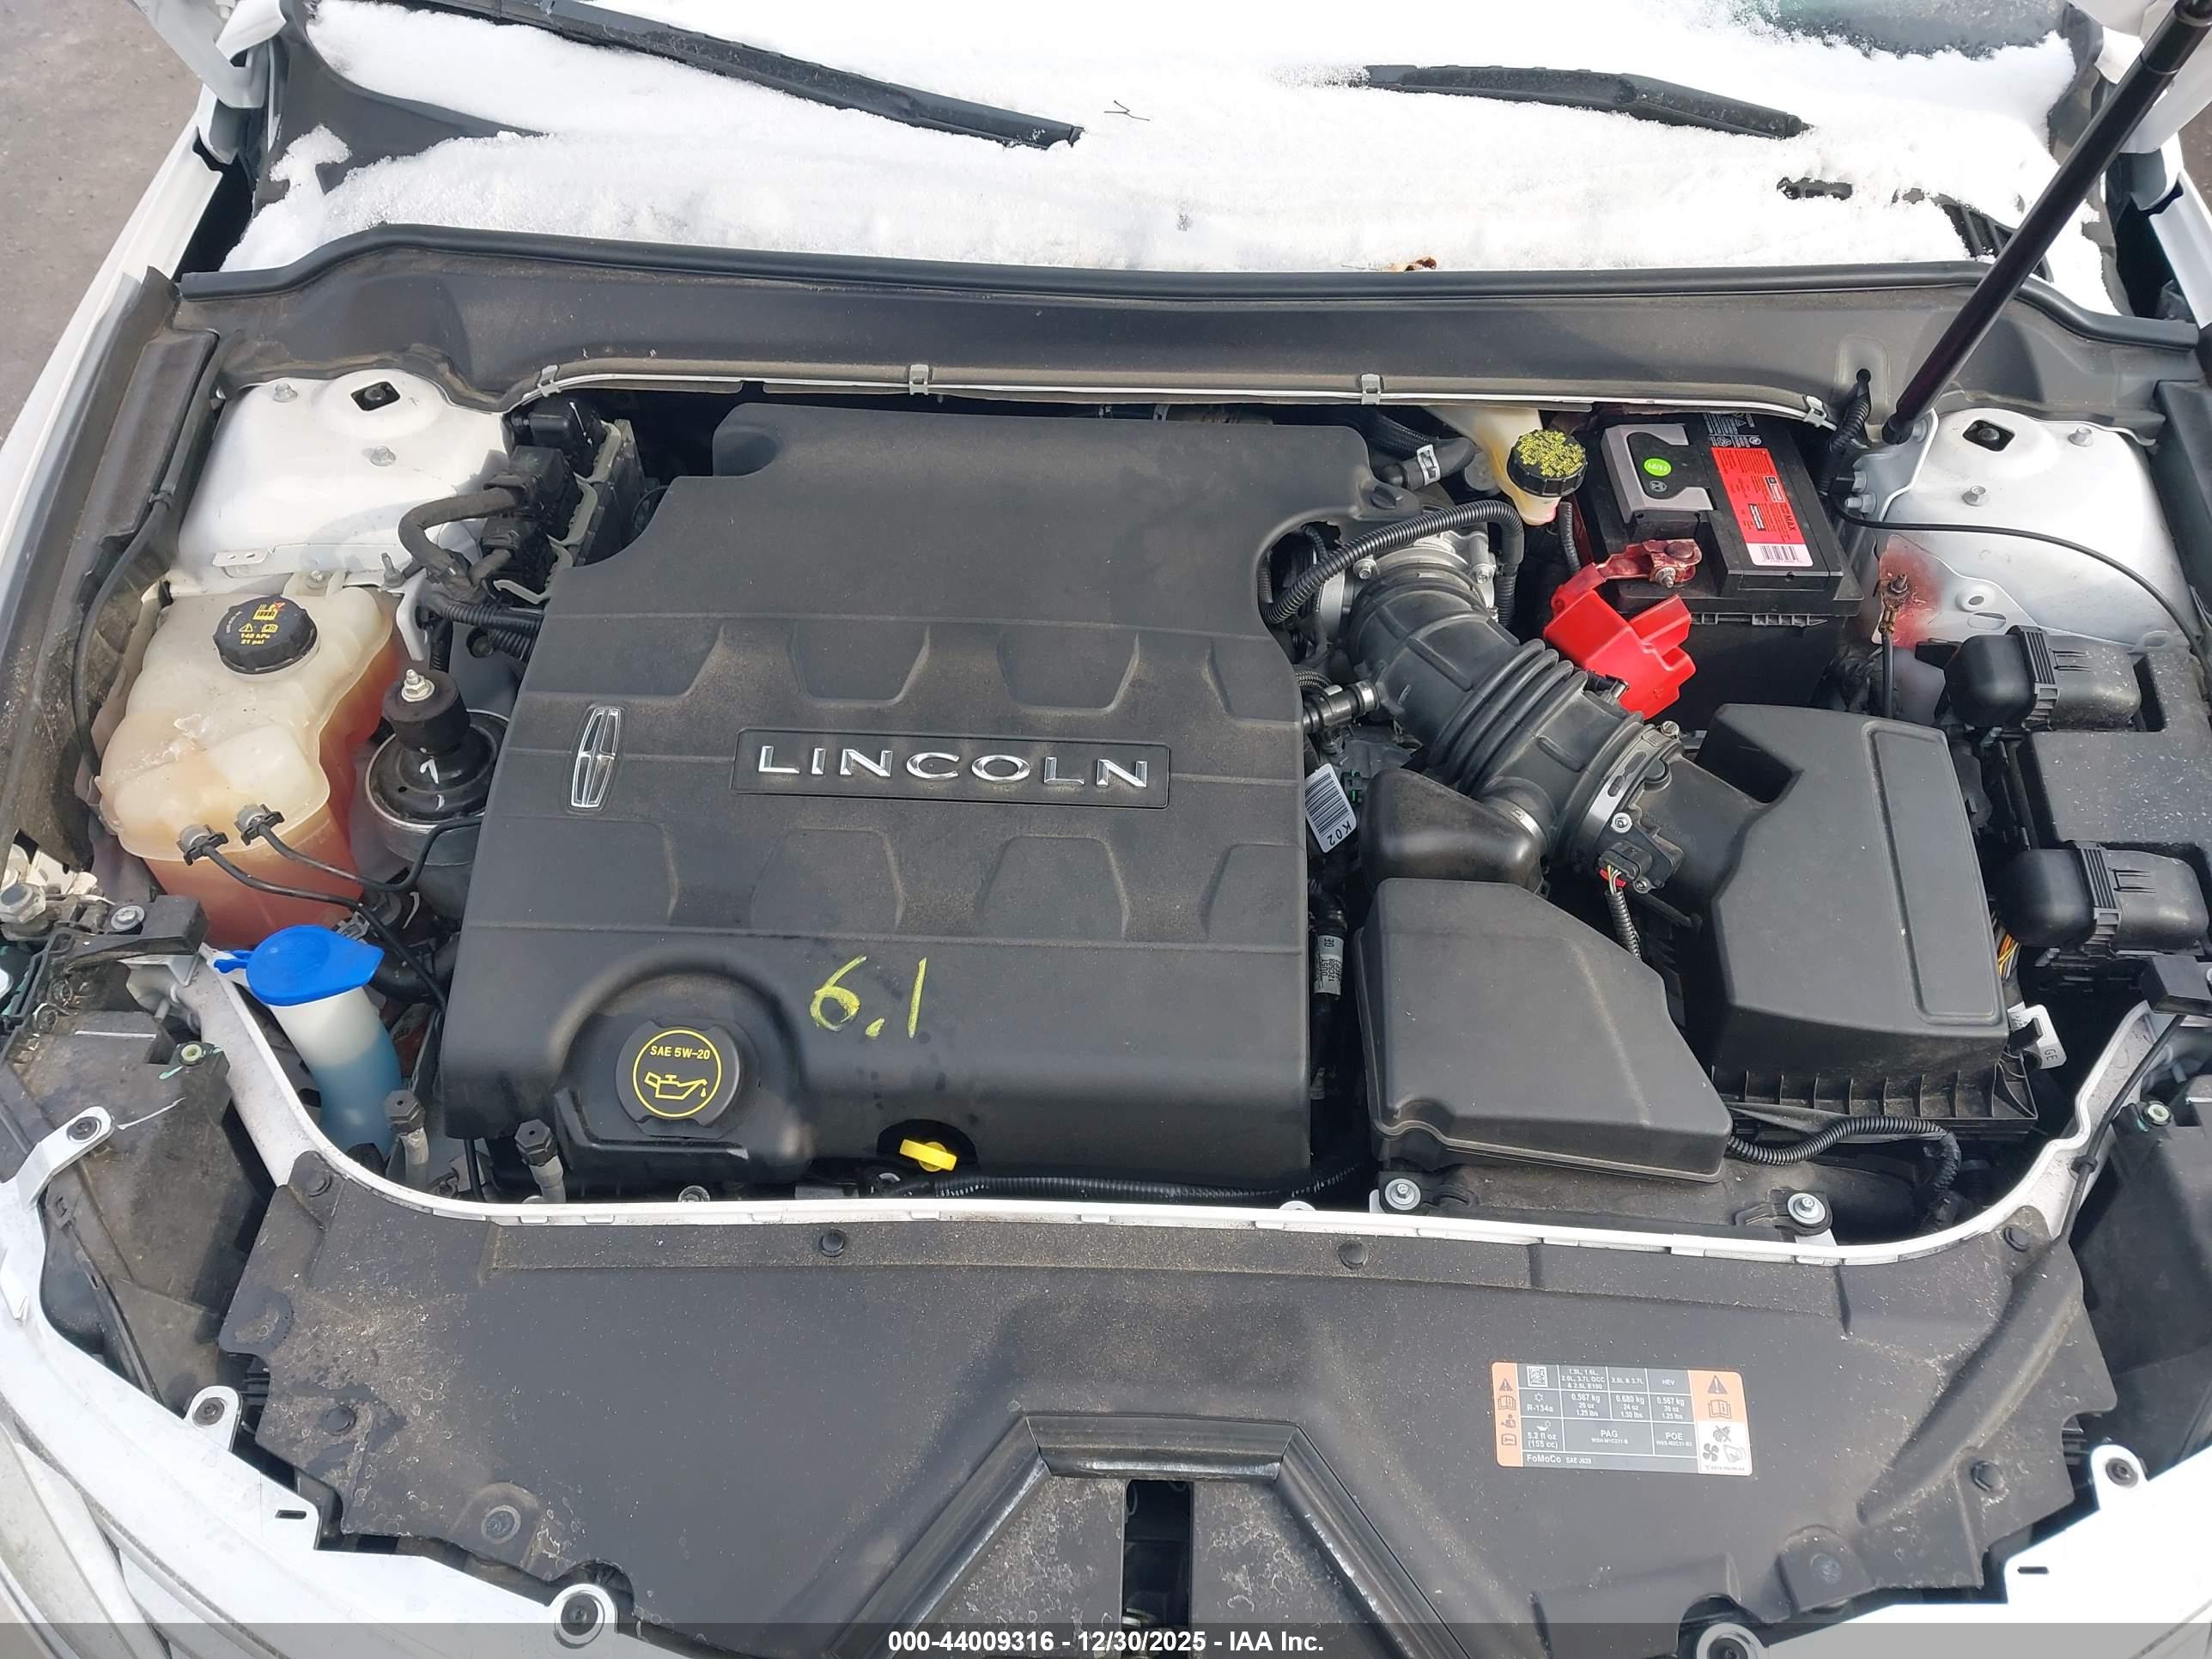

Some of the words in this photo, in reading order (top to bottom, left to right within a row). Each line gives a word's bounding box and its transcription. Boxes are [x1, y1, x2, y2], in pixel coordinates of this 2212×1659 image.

[758, 744, 1148, 788] LINCOLN
[1327, 820, 1352, 846] K02
[810, 955, 927, 1039] 6.1
[650, 1044, 672, 1058] SAE
[673, 1045, 711, 1060] 5W-20
[2045, 1048, 2058, 1061] GE
[1571, 1393, 1589, 1401] 0.567
[1591, 1394, 1601, 1403] kg
[1615, 1395, 1635, 1403] 0.680
[1636, 1395, 1645, 1405] kg
[1656, 1396, 1674, 1405] 0.567
[1675, 1397, 1685, 1407] kg
[1526, 1404, 1553, 1413] R-134a
[1527, 1431, 1539, 1440] 5.2
[1600, 1429, 1618, 1437] PAG
[1665, 1431, 1683, 1441] POE
[1528, 1440, 1545, 1449] (155
[1546, 1441, 1559, 1449] cc)
[1526, 1454, 1562, 1463] FoMoCo
